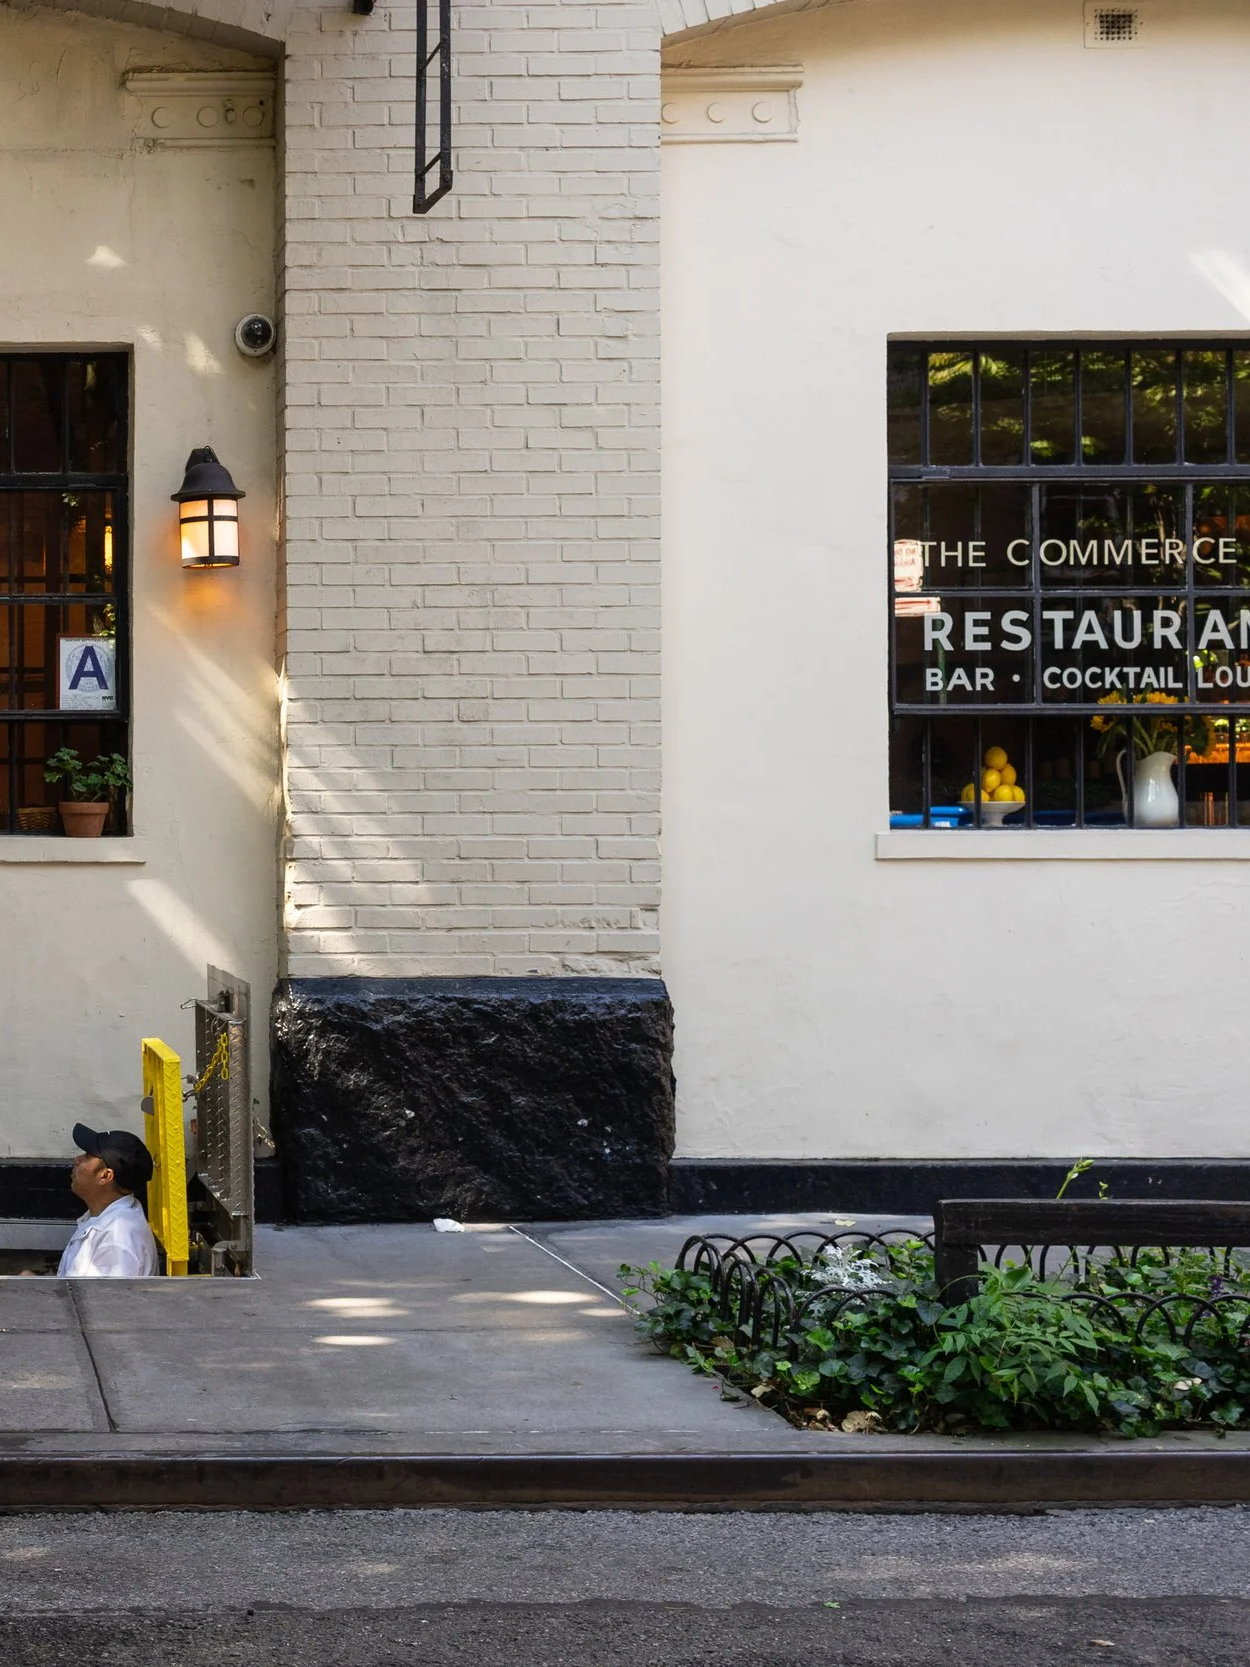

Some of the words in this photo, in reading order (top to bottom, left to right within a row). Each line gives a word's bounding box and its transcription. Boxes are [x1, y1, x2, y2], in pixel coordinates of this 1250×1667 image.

[921, 541, 987, 567] THE
[1006, 538, 1237, 566] COMMERCE
[68, 646, 109, 690] A
[926, 667, 995, 691] BAR
[1043, 667, 1183, 689] COCKTAIL
